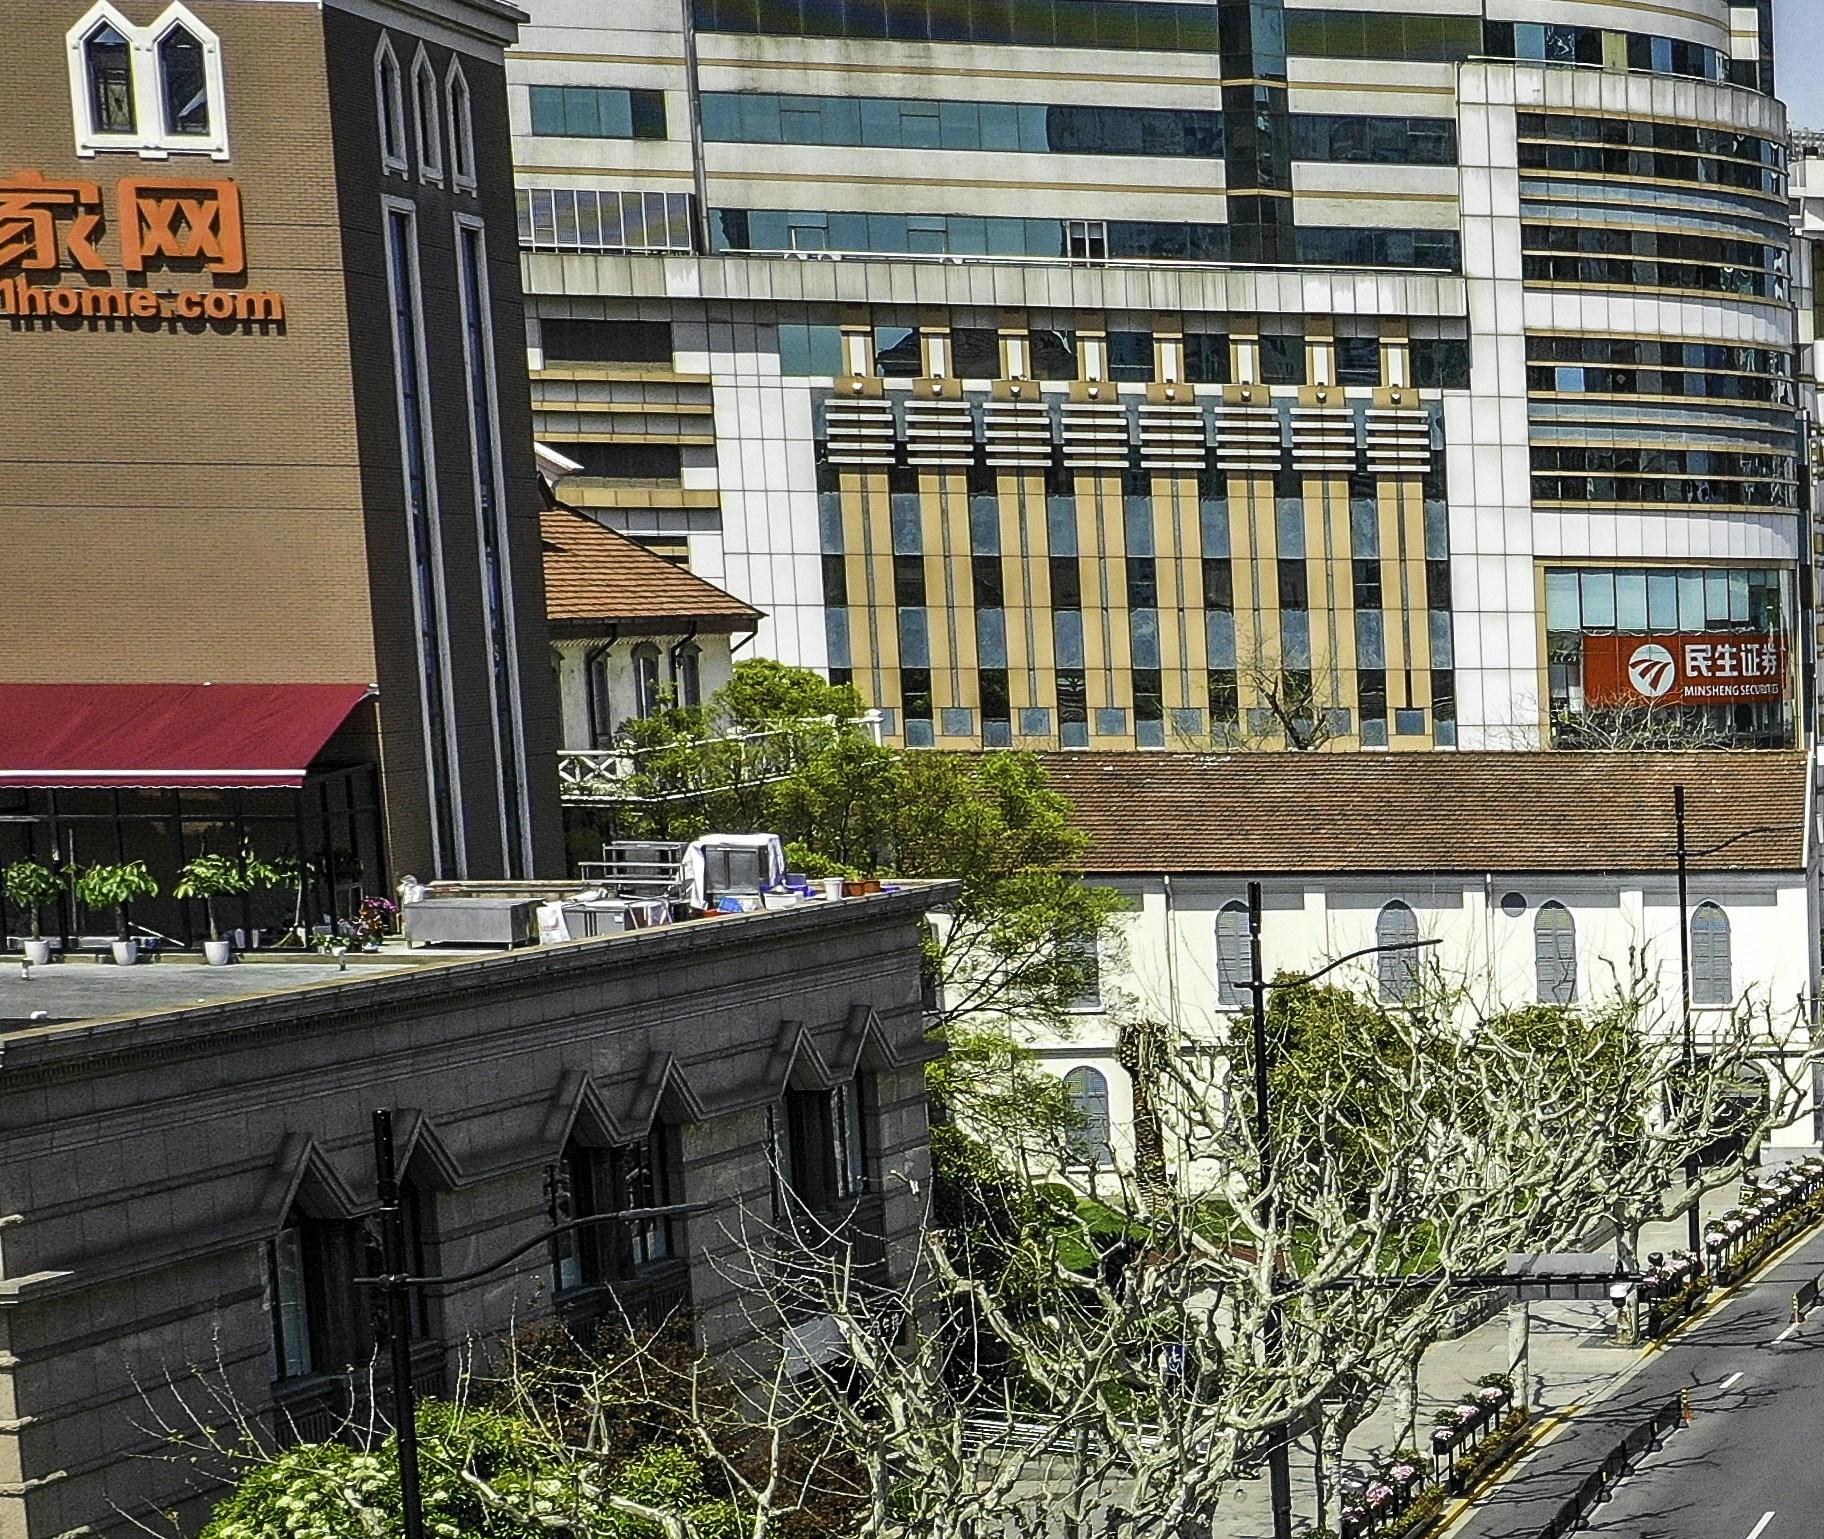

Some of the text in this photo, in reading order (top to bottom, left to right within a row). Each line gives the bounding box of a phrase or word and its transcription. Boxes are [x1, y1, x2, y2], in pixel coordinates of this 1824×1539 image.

[1684, 643, 1778, 677] 民生证券
[1684, 684, 1739, 697] MINSHENG
